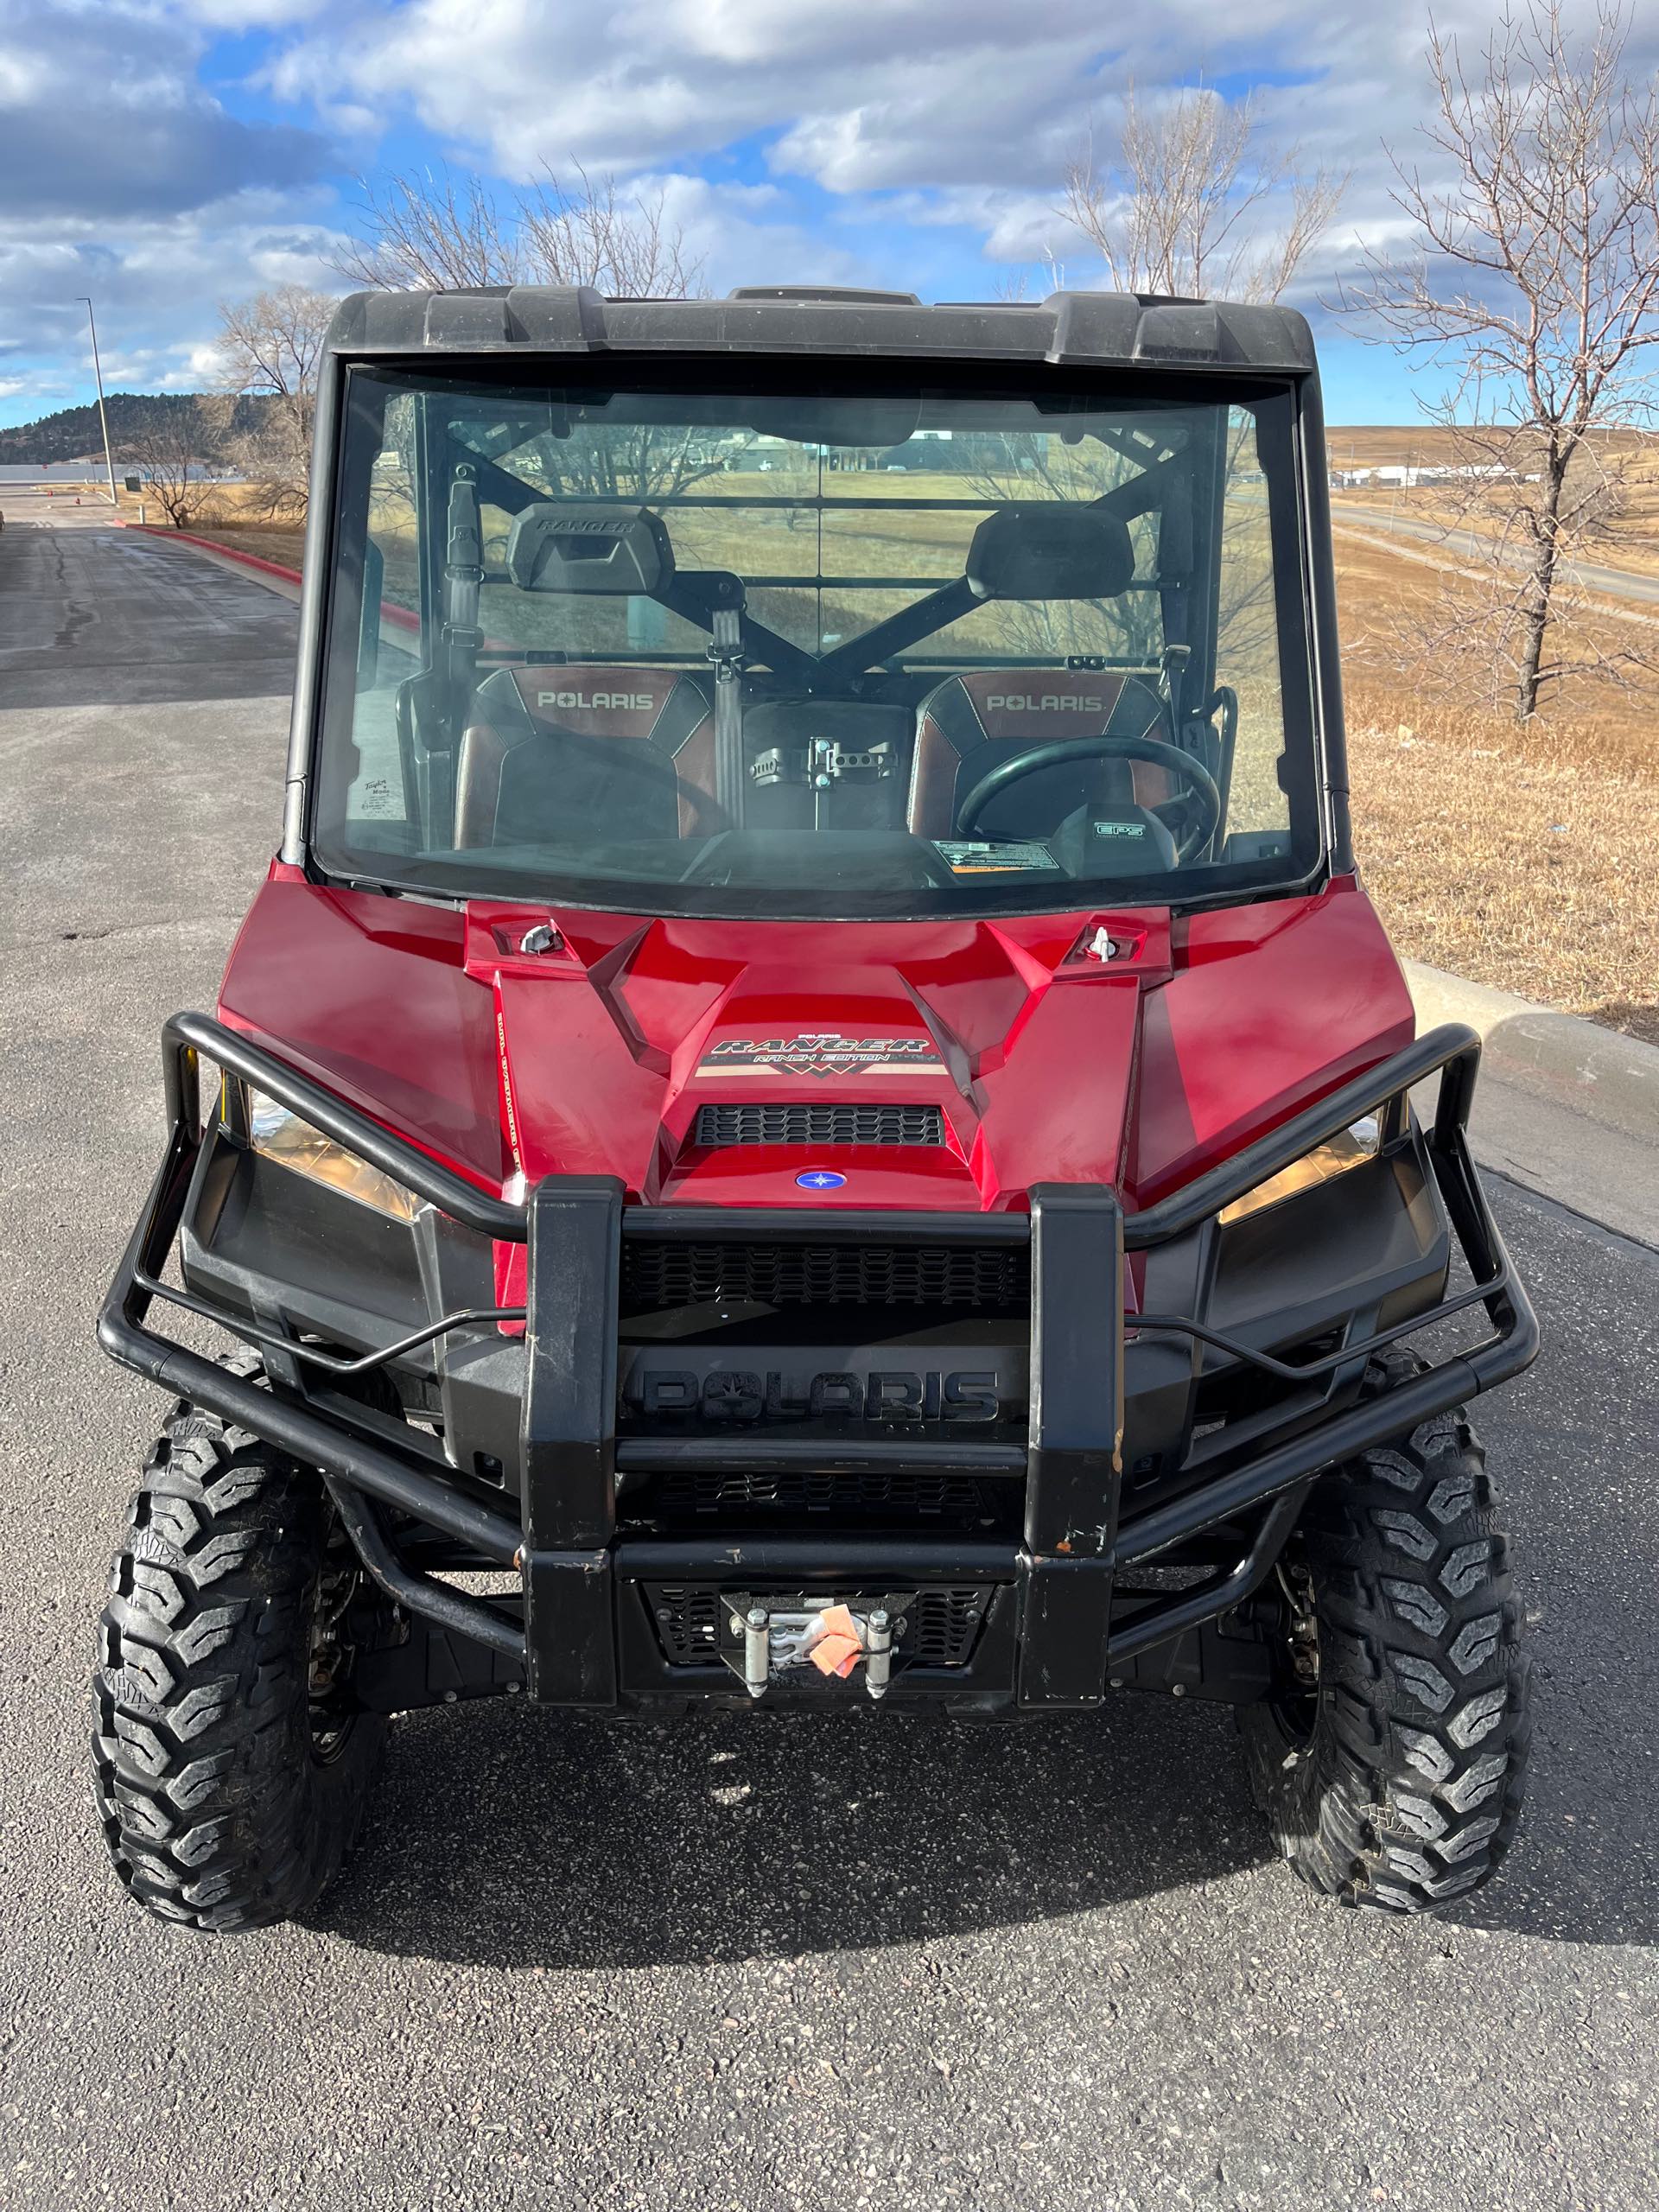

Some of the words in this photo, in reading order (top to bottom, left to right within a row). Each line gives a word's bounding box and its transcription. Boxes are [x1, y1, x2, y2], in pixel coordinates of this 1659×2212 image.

[537, 518, 636, 533] RANGER
[537, 691, 653, 709] POLARIS
[987, 695, 1103, 711] POLARIS
[1096, 825, 1143, 836] EPS
[710, 1039, 931, 1054] RANGER
[753, 1053, 817, 1063] RANCH
[820, 1053, 891, 1063] EDITION
[643, 1371, 999, 1421] POLARIS
